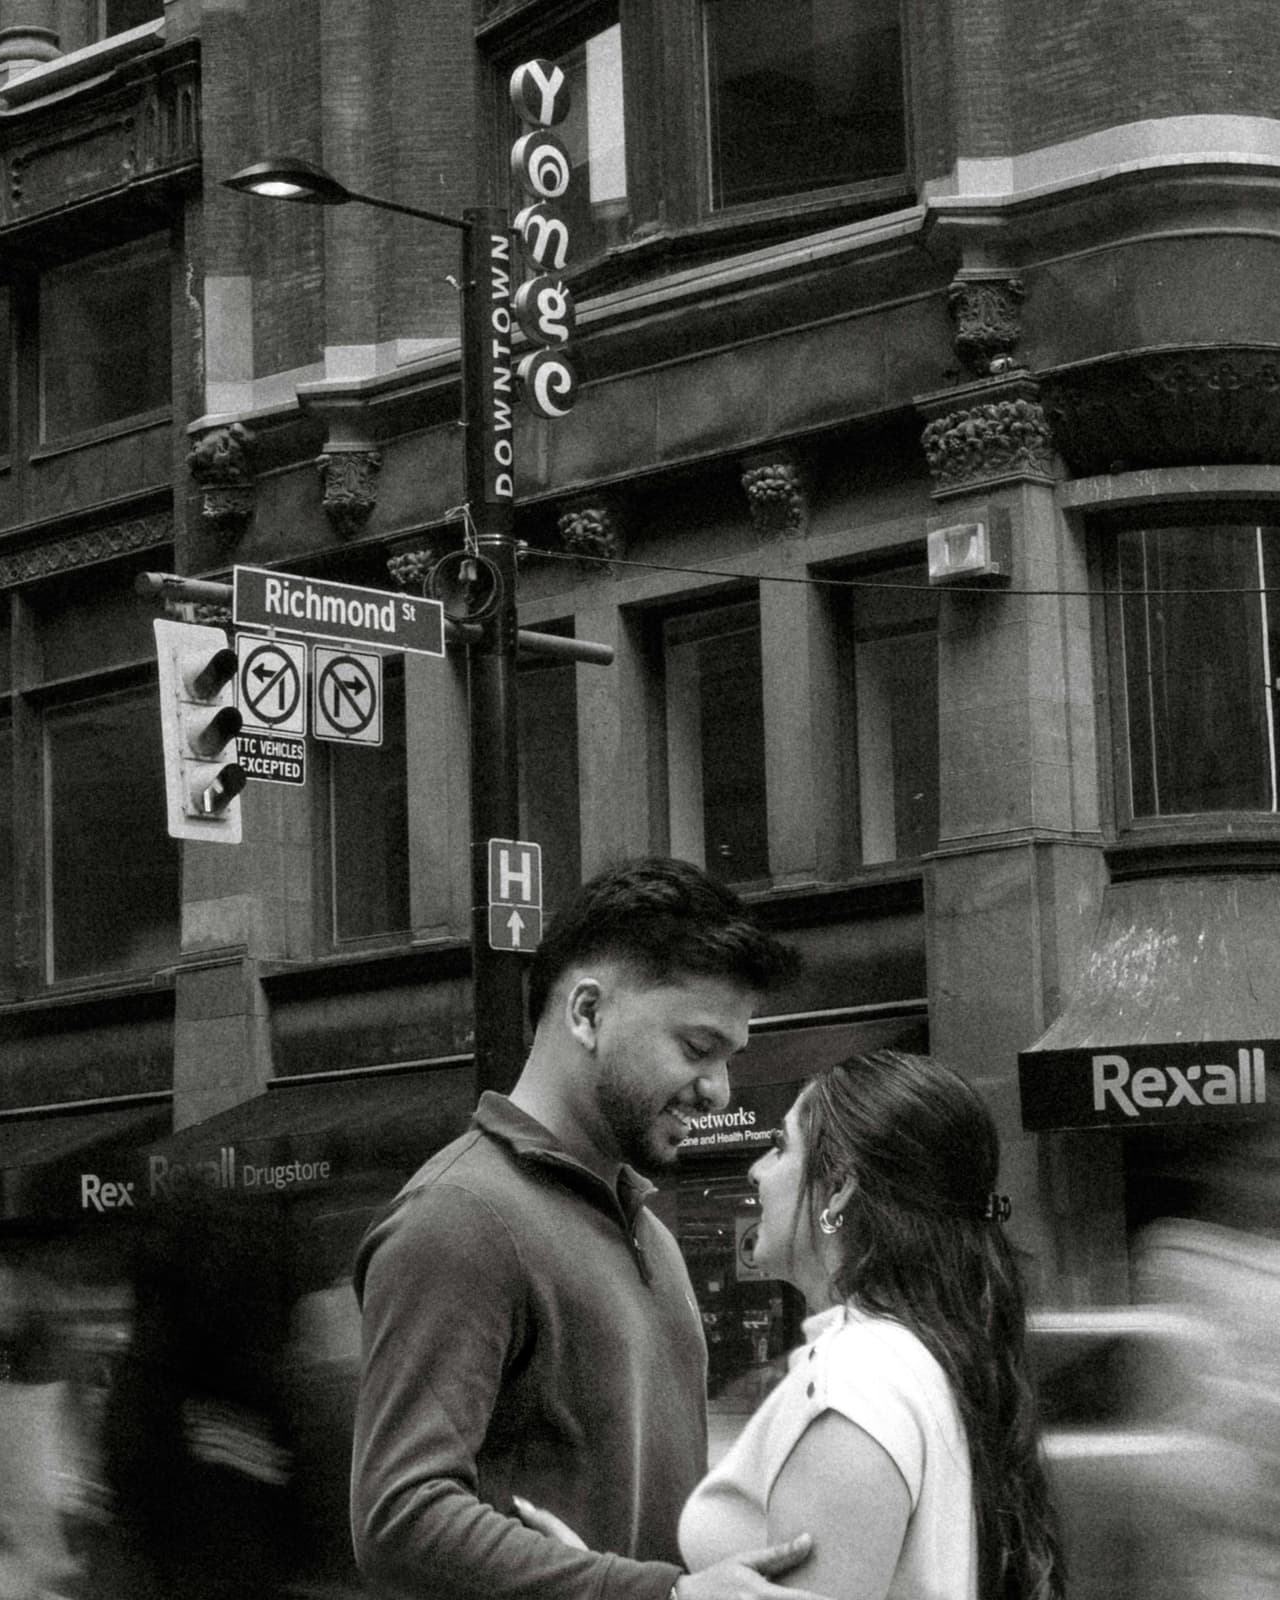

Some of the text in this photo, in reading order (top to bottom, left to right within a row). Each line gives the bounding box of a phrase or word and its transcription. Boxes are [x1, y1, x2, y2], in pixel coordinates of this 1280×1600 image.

[526, 60, 571, 416] Yonge
[492, 235, 514, 497] DOWNTOWN
[265, 578, 416, 633] Richmond St
[236, 736, 304, 760] TTC VEHICLES
[239, 756, 301, 778] EXCEPTED
[500, 849, 531, 902] H
[1092, 1048, 1266, 1116] Rexall
[243, 1159, 330, 1189] Drugstore
